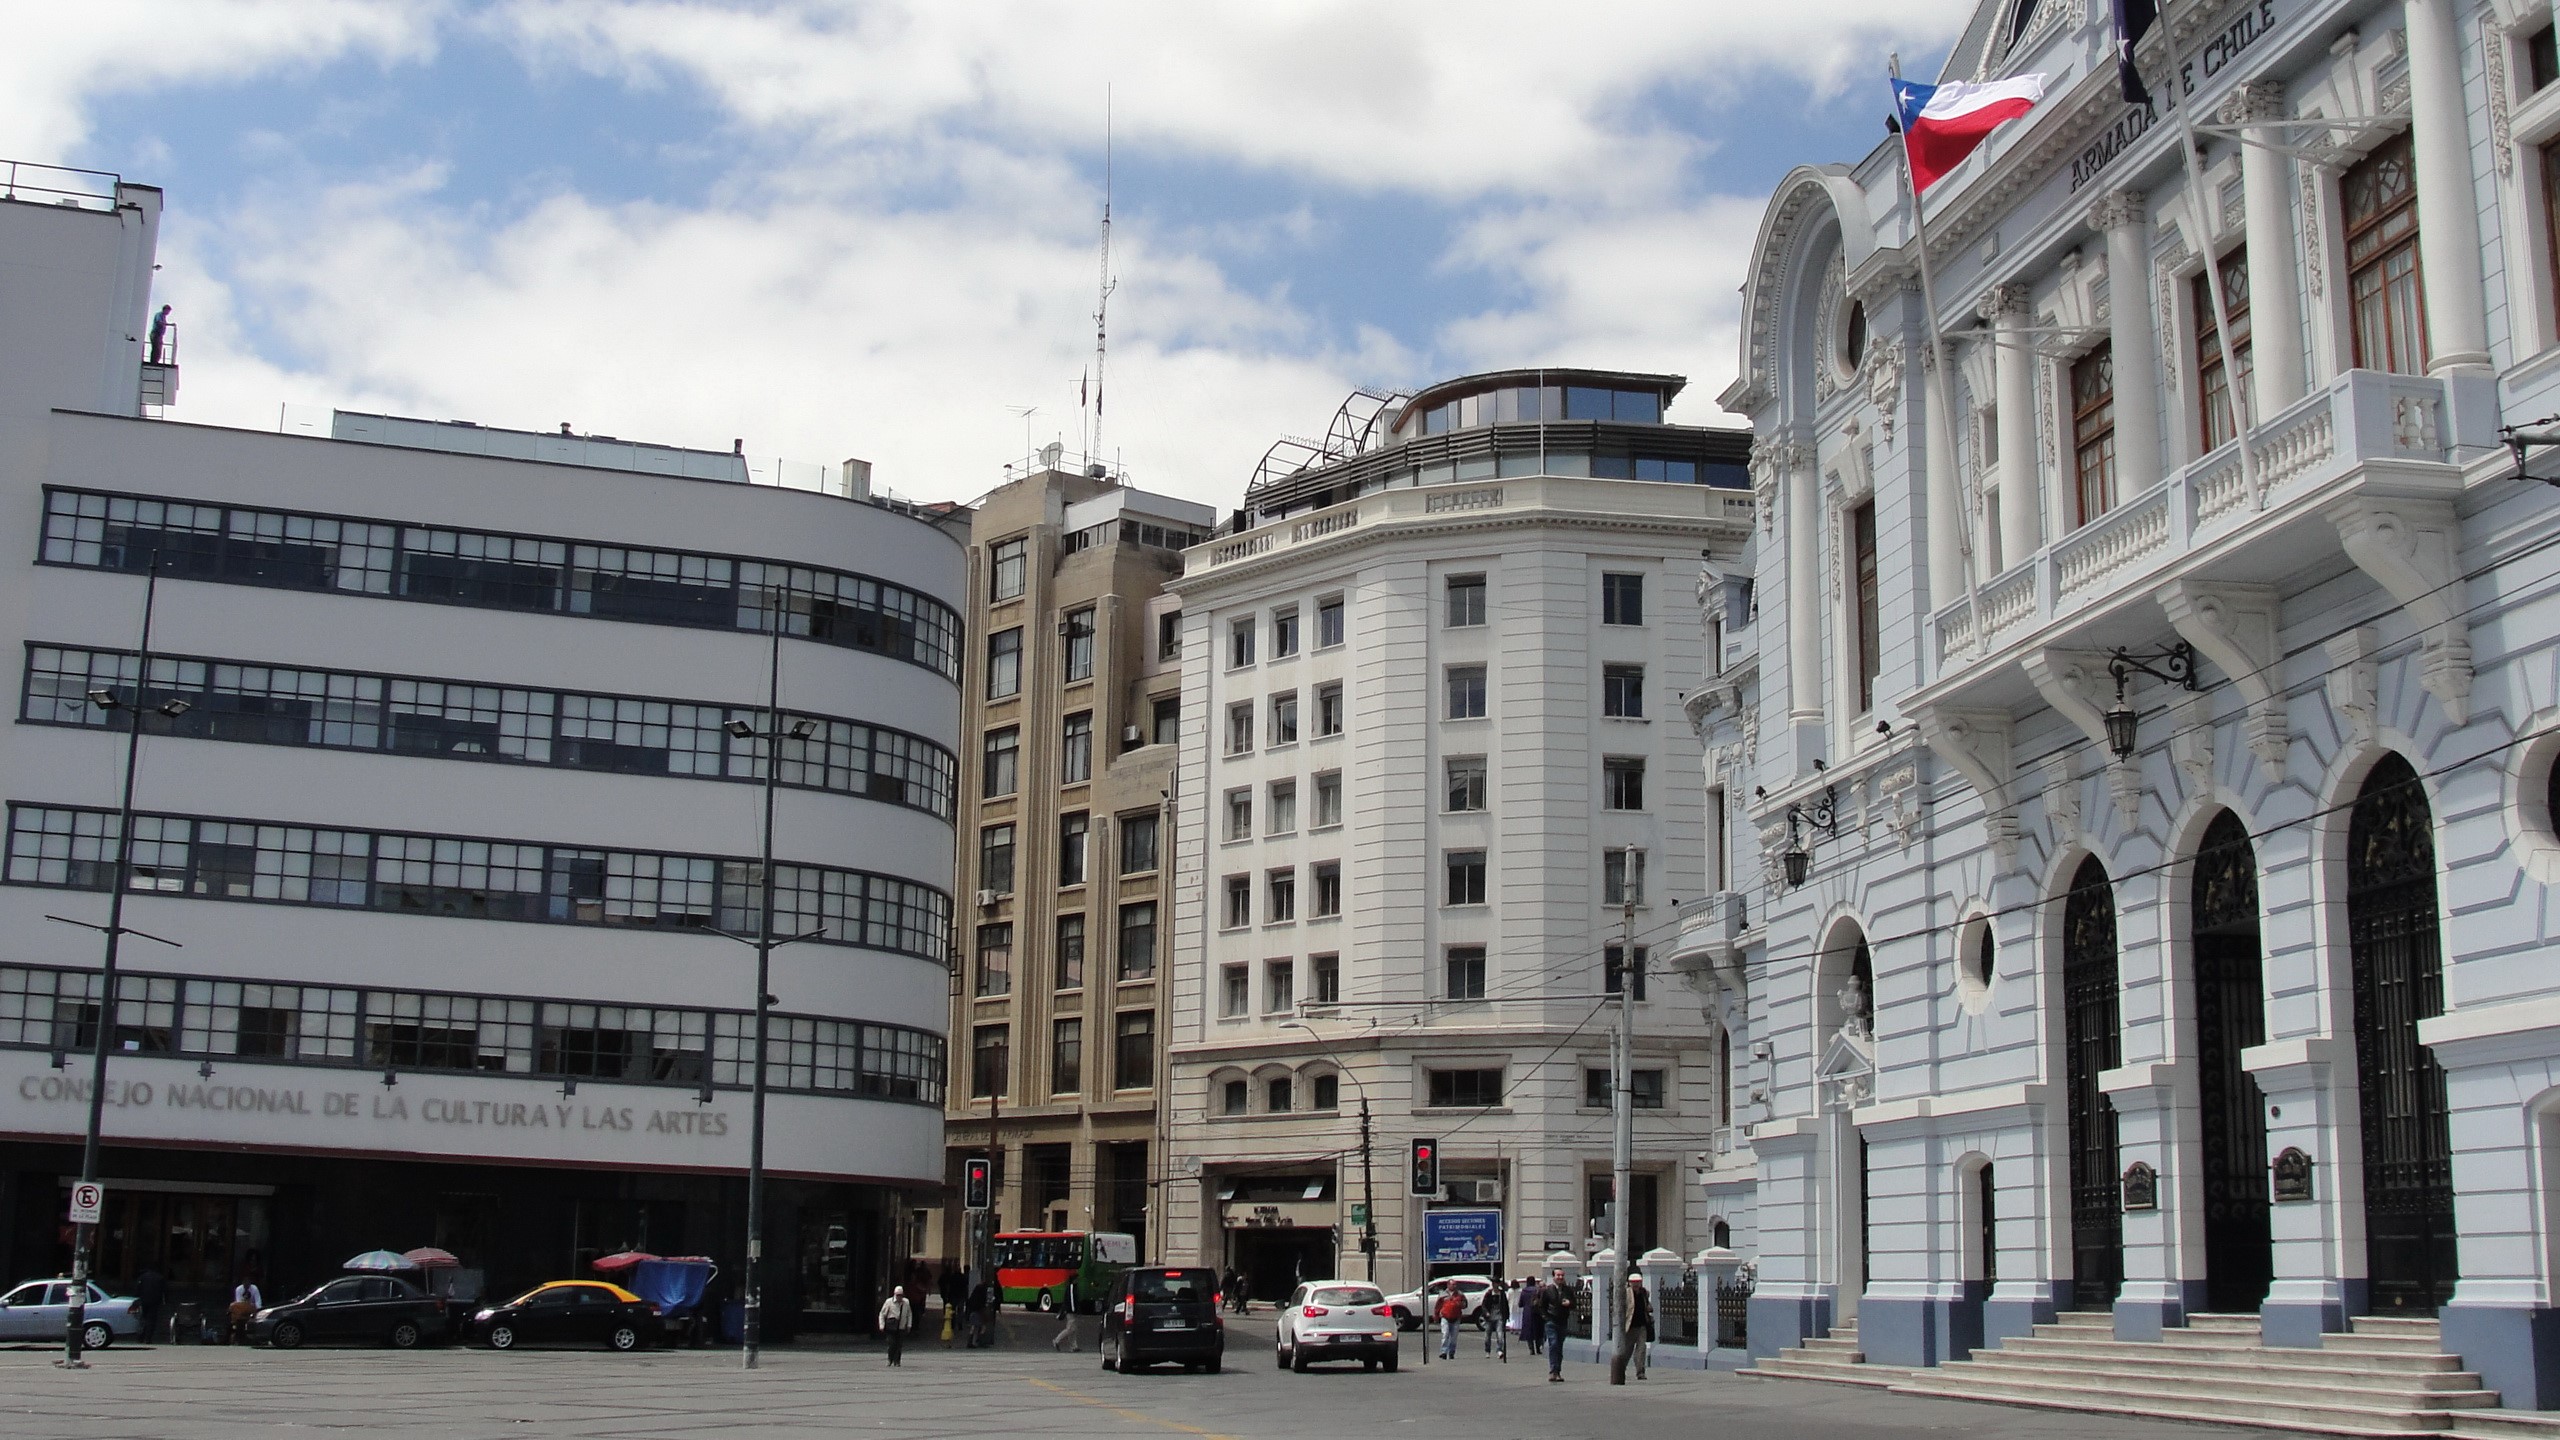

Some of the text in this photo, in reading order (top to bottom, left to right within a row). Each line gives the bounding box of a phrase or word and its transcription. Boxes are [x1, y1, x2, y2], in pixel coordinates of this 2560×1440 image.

[2070, 97, 2158, 195] ARMADA
[2203, 0, 2275, 78] CHILE
[167, 1084, 311, 1116] NACIONAL
[322, 1091, 360, 1117] DE
[373, 1094, 409, 1121] LA
[421, 1098, 550, 1128] CULTURA
[555, 1104, 572, 1129] Y
[582, 1105, 633, 1131] LAS
[645, 1109, 729, 1137] ARTES
